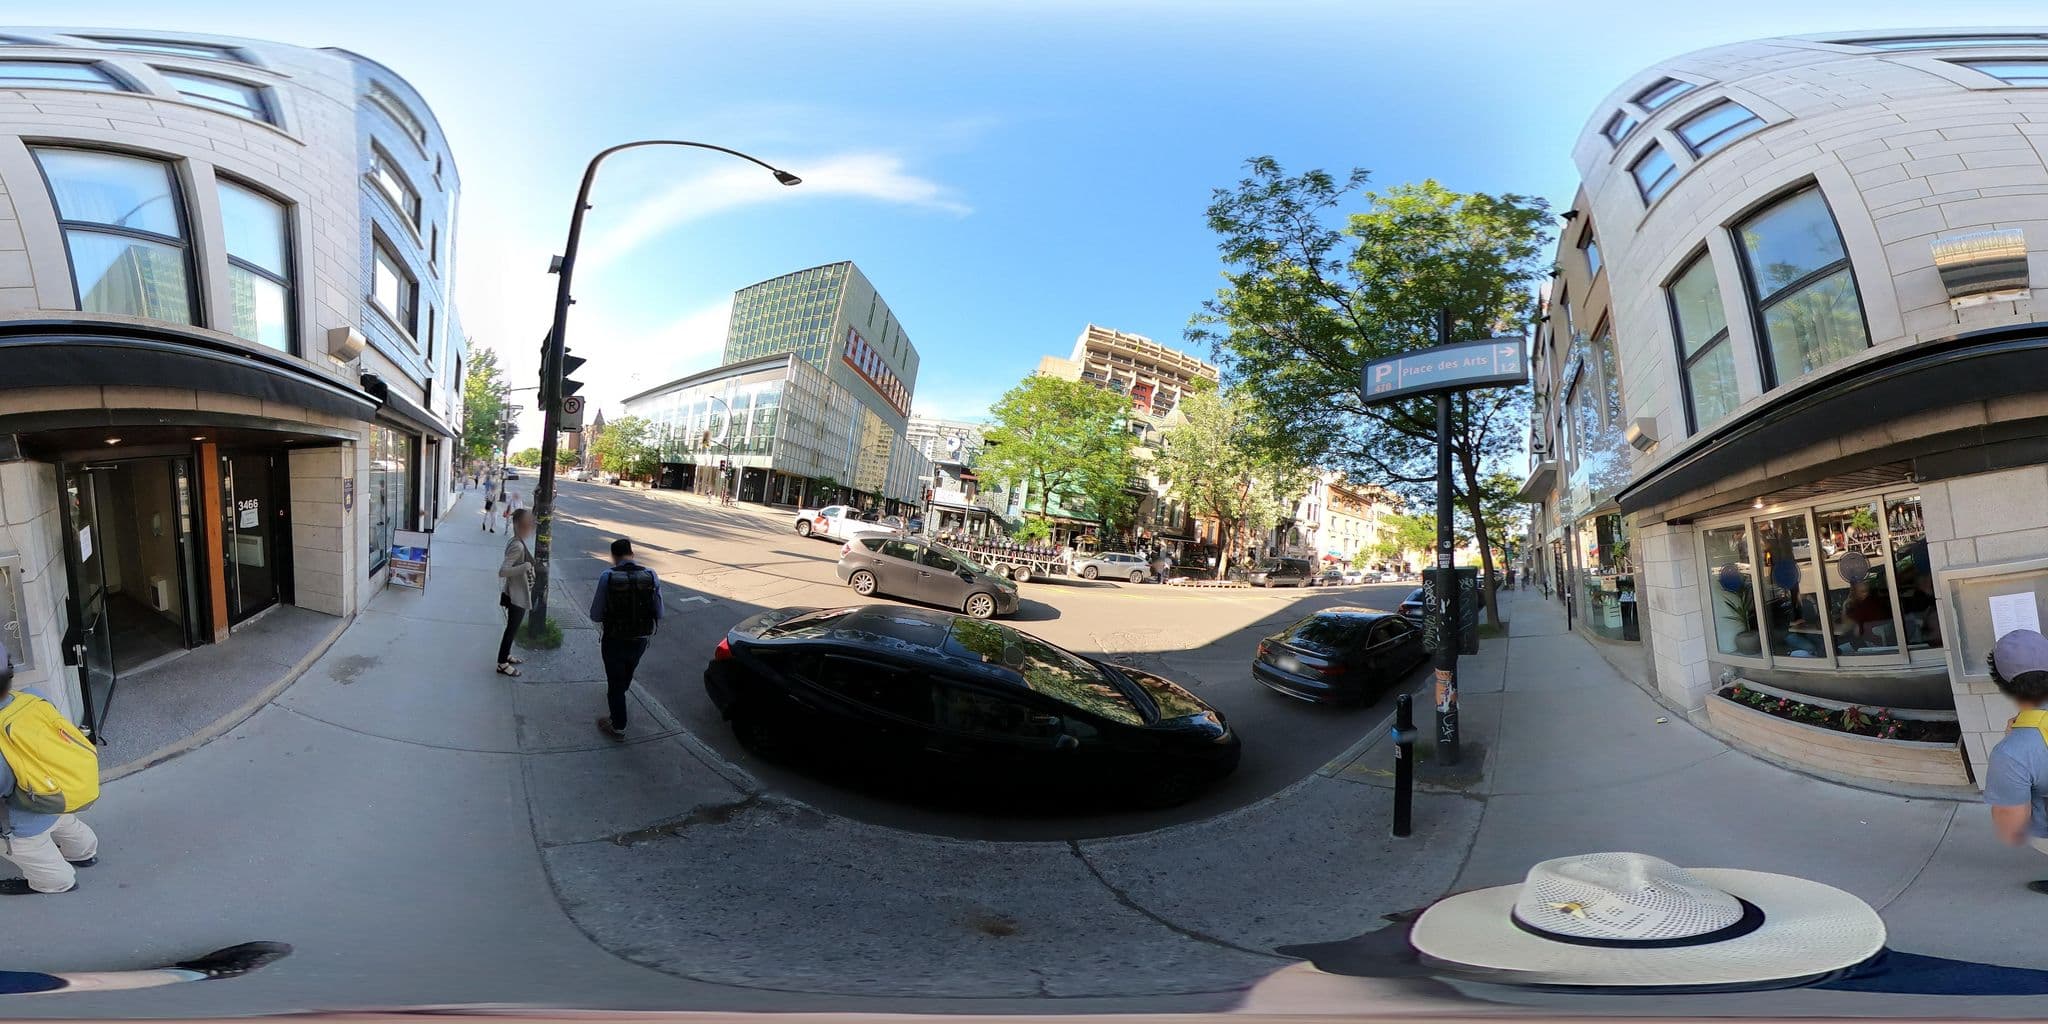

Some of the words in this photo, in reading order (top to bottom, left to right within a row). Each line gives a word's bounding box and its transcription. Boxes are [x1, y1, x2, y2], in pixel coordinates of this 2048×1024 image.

[1375, 364, 1393, 383] P
[1402, 365, 1433, 377] Place
[1438, 359, 1458, 370] des
[1463, 356, 1488, 368] Arts
[238, 498, 259, 511] 3466
